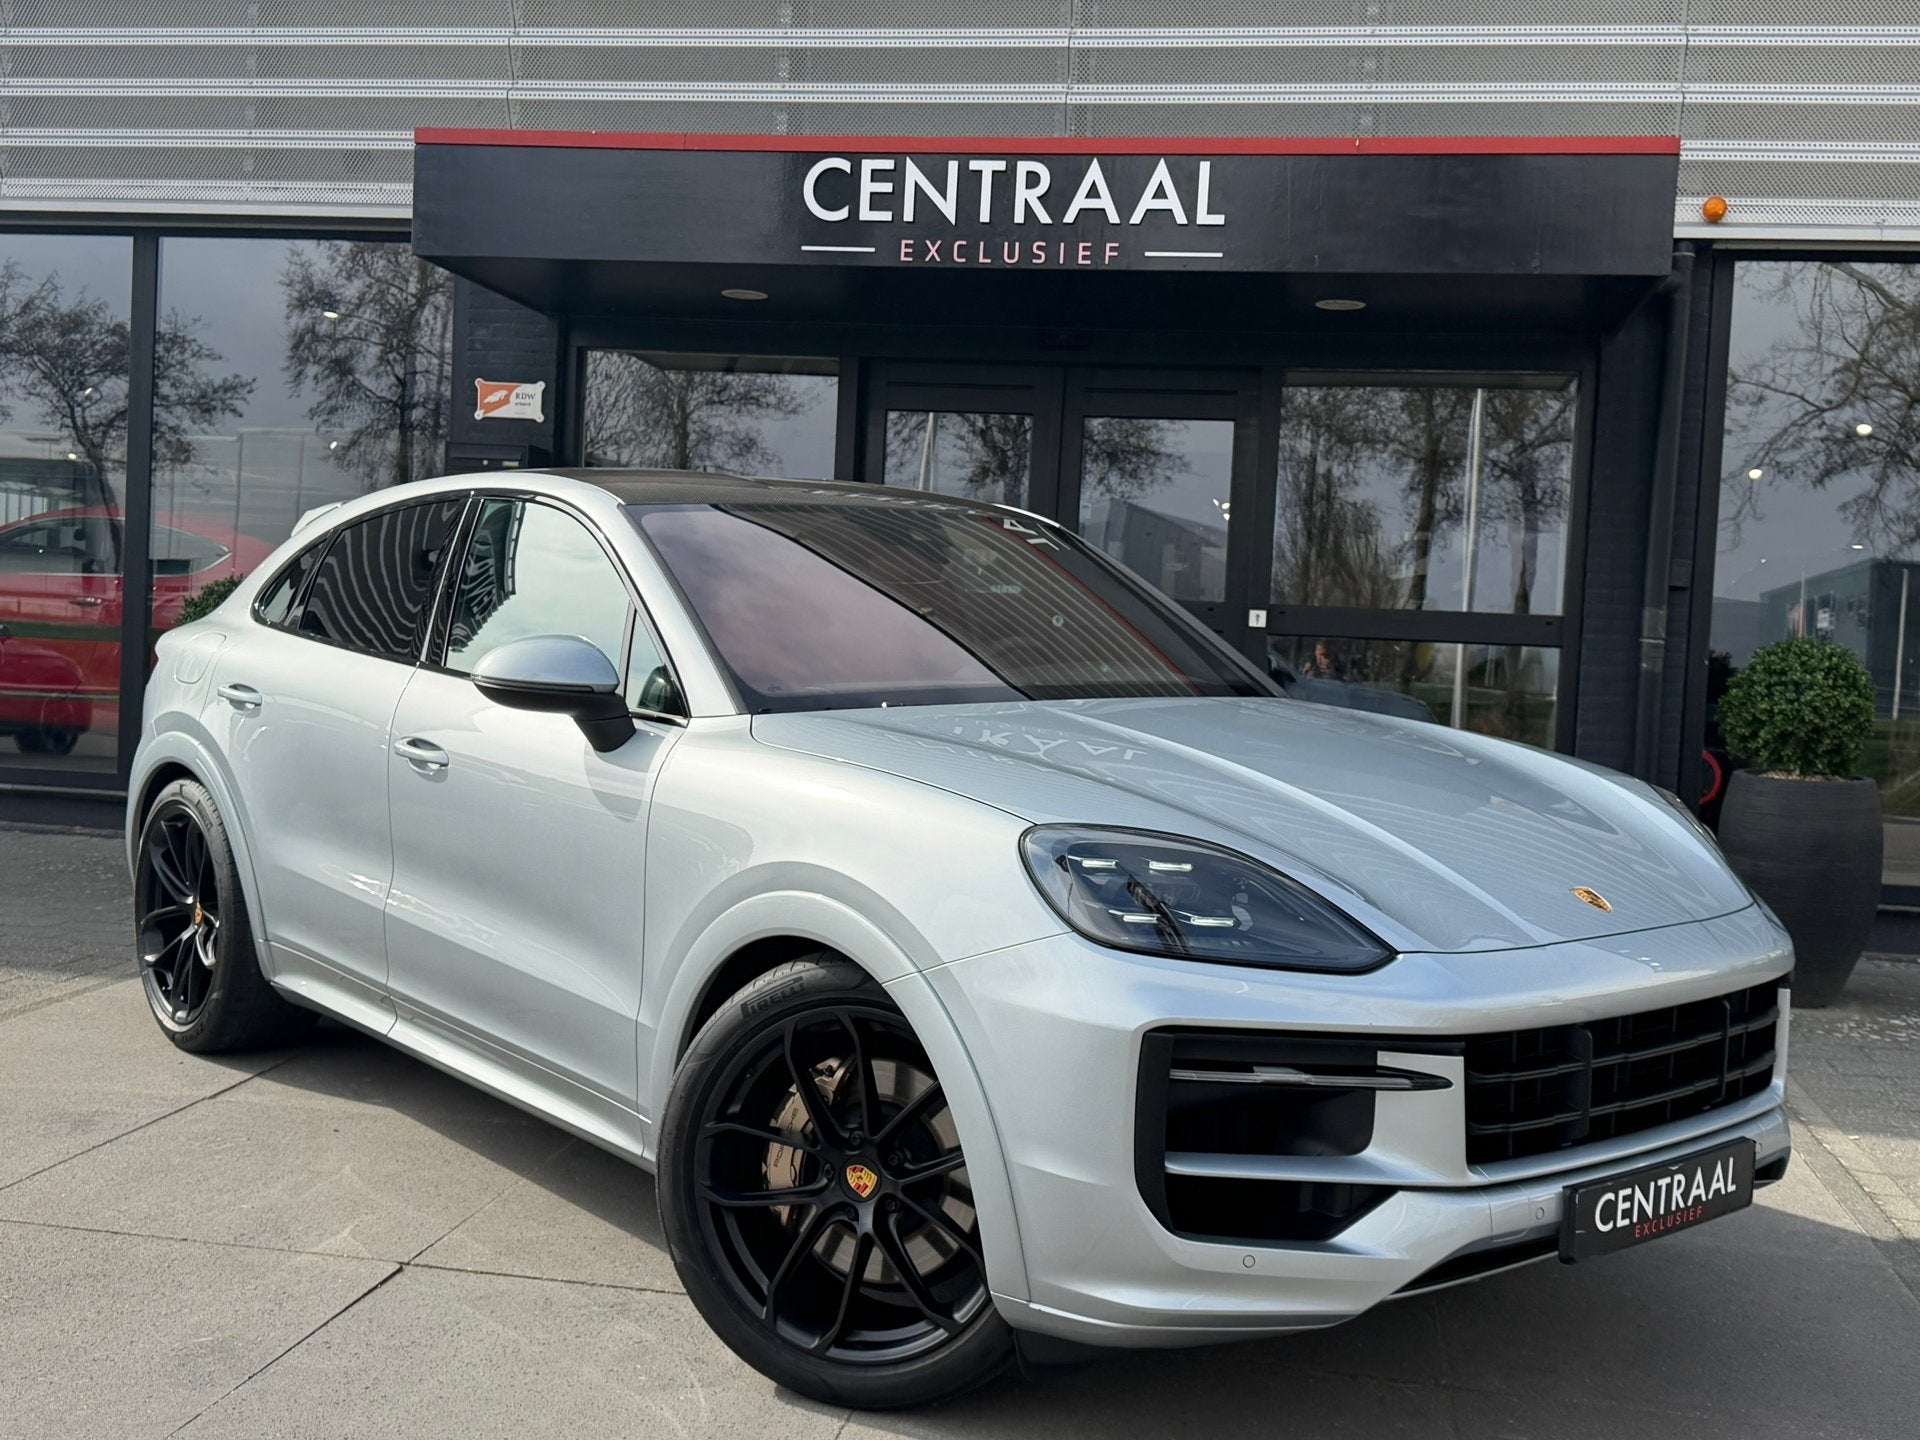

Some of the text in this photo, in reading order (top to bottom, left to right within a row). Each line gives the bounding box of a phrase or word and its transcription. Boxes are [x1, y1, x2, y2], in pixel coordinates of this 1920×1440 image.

[803, 156, 1226, 226] CENTRAAL
[899, 239, 1120, 265] EXCLUSIEF
[515, 392, 536, 400] RDW
[740, 975, 806, 1020] PIRELLI
[1594, 1157, 1737, 1232] CENTRAAL
[1635, 1206, 1703, 1238] EXCLUSIEF
